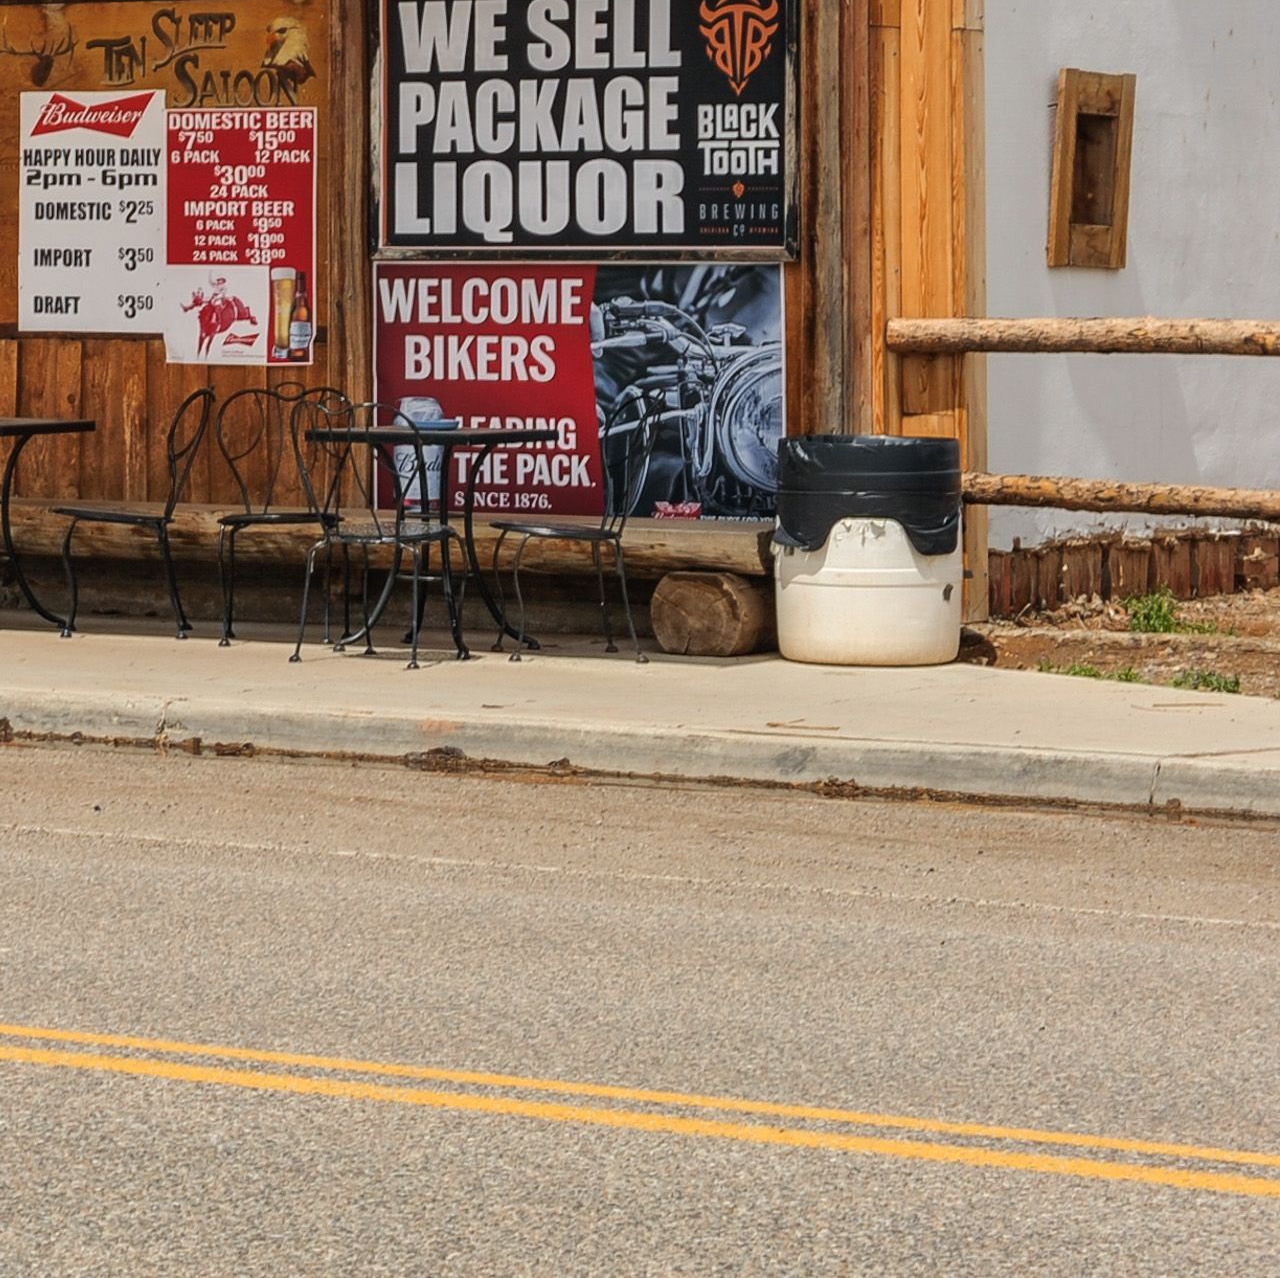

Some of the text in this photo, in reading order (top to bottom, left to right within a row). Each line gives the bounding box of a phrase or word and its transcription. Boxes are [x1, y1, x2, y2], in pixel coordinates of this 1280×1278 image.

[151, 7, 236, 72] SLEEP
[85, 35, 147, 86] TEN
[172, 53, 299, 108] SALOON
[40, 102, 142, 126] Budweiser
[168, 112, 313, 130] DOMESTIC BEER
[398, 76, 681, 154] PACKAGE
[698, 103, 780, 139] BLACK
[23, 148, 161, 167] HAPPY HOUR DAILY
[171, 150, 220, 164] 6 PACK
[255, 150, 310, 163] 12 PACK
[697, 140, 780, 175] TOOTH
[26, 169, 82, 190] 2pm
[101, 169, 158, 190] 6pm
[210, 185, 268, 198] 24 PACK
[394, 158, 684, 242] LIQUOR
[34, 202, 112, 220] DOMESTIC
[184, 201, 294, 217] IMPORT BEER
[699, 204, 778, 219] BREWING
[196, 220, 204, 231] 6
[206, 220, 235, 230] PACK
[194, 235, 206, 246] 12
[208, 235, 236, 246] PACK
[33, 248, 92, 267] IMPORT
[193, 250, 207, 261] 24
[209, 250, 238, 261] PACK
[33, 296, 80, 314] DRAFT
[379, 277, 584, 325] WELCOME
[404, 335, 556, 382] BIKERS
[454, 453, 597, 488] THE PACK.
[455, 491, 552, 509] SNCE 1876.
